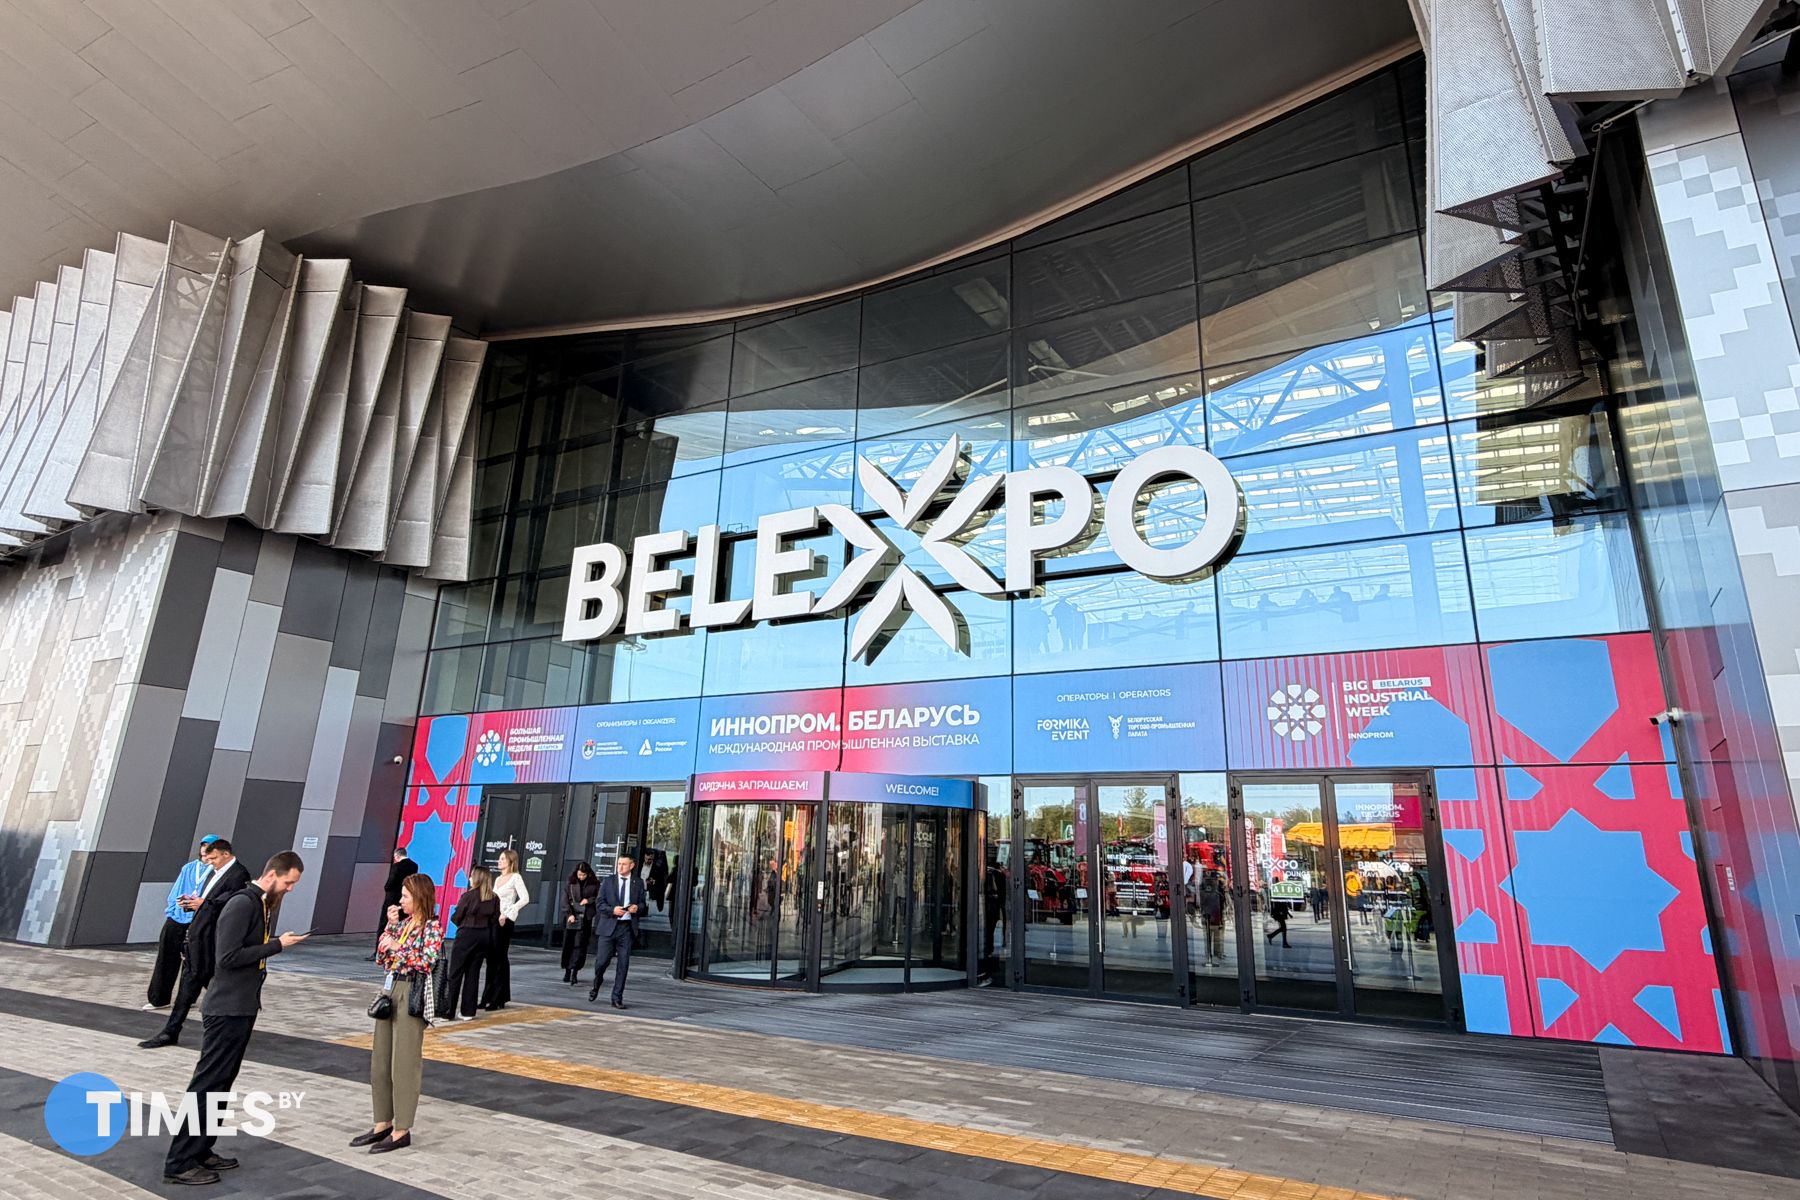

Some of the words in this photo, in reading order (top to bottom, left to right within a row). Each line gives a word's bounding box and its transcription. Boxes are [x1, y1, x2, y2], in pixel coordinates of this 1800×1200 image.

[561, 433, 1241, 662] BELEXPO
[1342, 680, 1368, 691] BIG
[1379, 679, 1424, 688] BELARUS
[1056, 692, 1109, 702] ОПЕРАТОРЫ
[1119, 689, 1171, 699] OPERATORS
[1344, 690, 1433, 704] INDUSTRIAL
[1345, 706, 1391, 717] WEEK
[643, 717, 676, 725] ORGANIZERS
[710, 712, 841, 737] ИННОПРОМ.
[848, 704, 980, 731] БЕЛАРУСЬ
[1037, 718, 1090, 731] FORMIKA
[508, 734, 564, 744] ПРОМЫШЛЕННАЯ
[1051, 730, 1090, 741] EVENT
[1348, 731, 1394, 740] INNOPROM
[507, 744, 533, 752] НЕДЕЛЯ
[709, 739, 804, 755] МЕЖДУНАРОДНАЯ
[912, 733, 980, 747] ВЫСТАВКА
[699, 781, 736, 792] САРДЭЧНА
[737, 780, 809, 791] ЗАПРАШАЕМ!
[885, 784, 939, 797] WELCOME!
[1355, 803, 1405, 811] INNOPROM.
